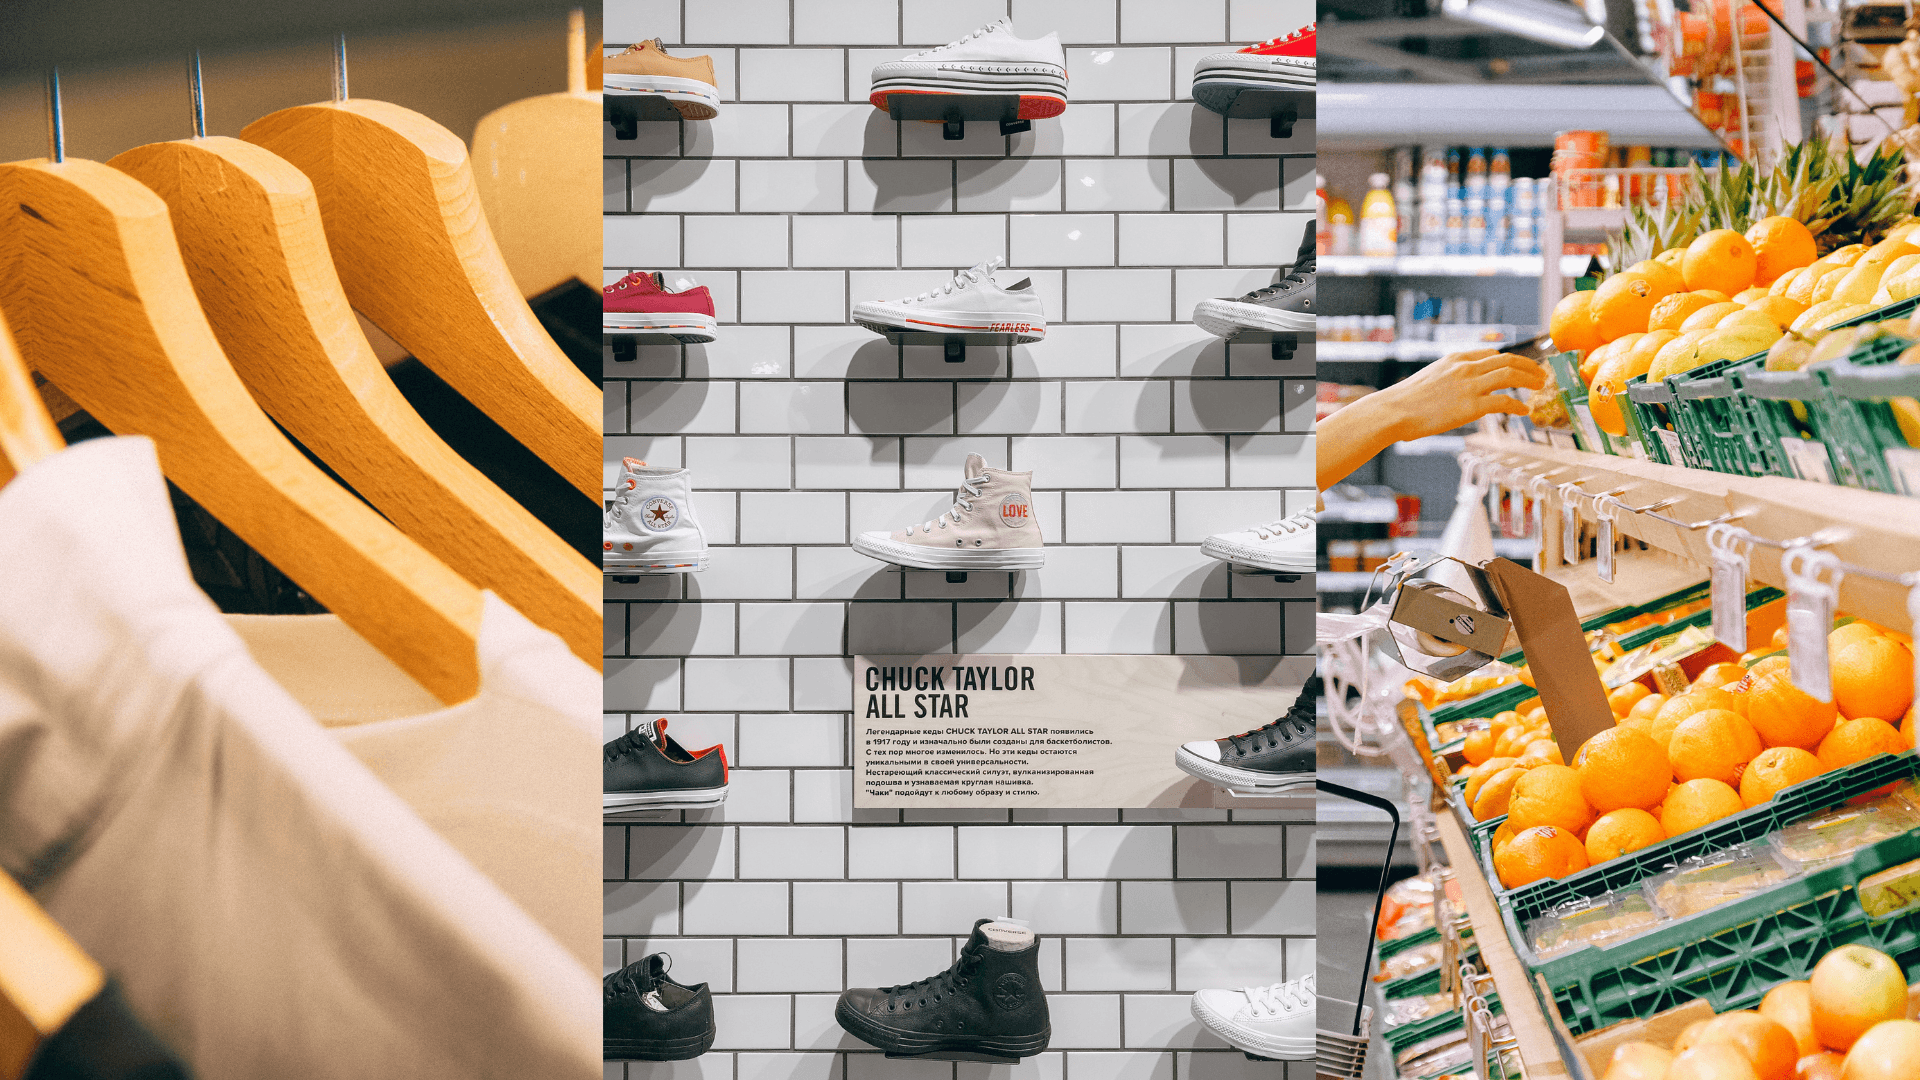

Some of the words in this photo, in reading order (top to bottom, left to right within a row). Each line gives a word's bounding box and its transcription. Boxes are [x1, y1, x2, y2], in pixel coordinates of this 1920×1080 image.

[990, 322, 1031, 333] FEARLESS
[646, 499, 674, 510] CONVERSE
[1002, 504, 1029, 518] LOVE
[865, 665, 944, 692] CHUCK
[951, 665, 1035, 691] TAYLOR
[865, 693, 906, 719] ALL
[913, 693, 969, 719] STAR
[866, 728, 921, 736] Легендарные
[941, 789, 973, 797] любому
